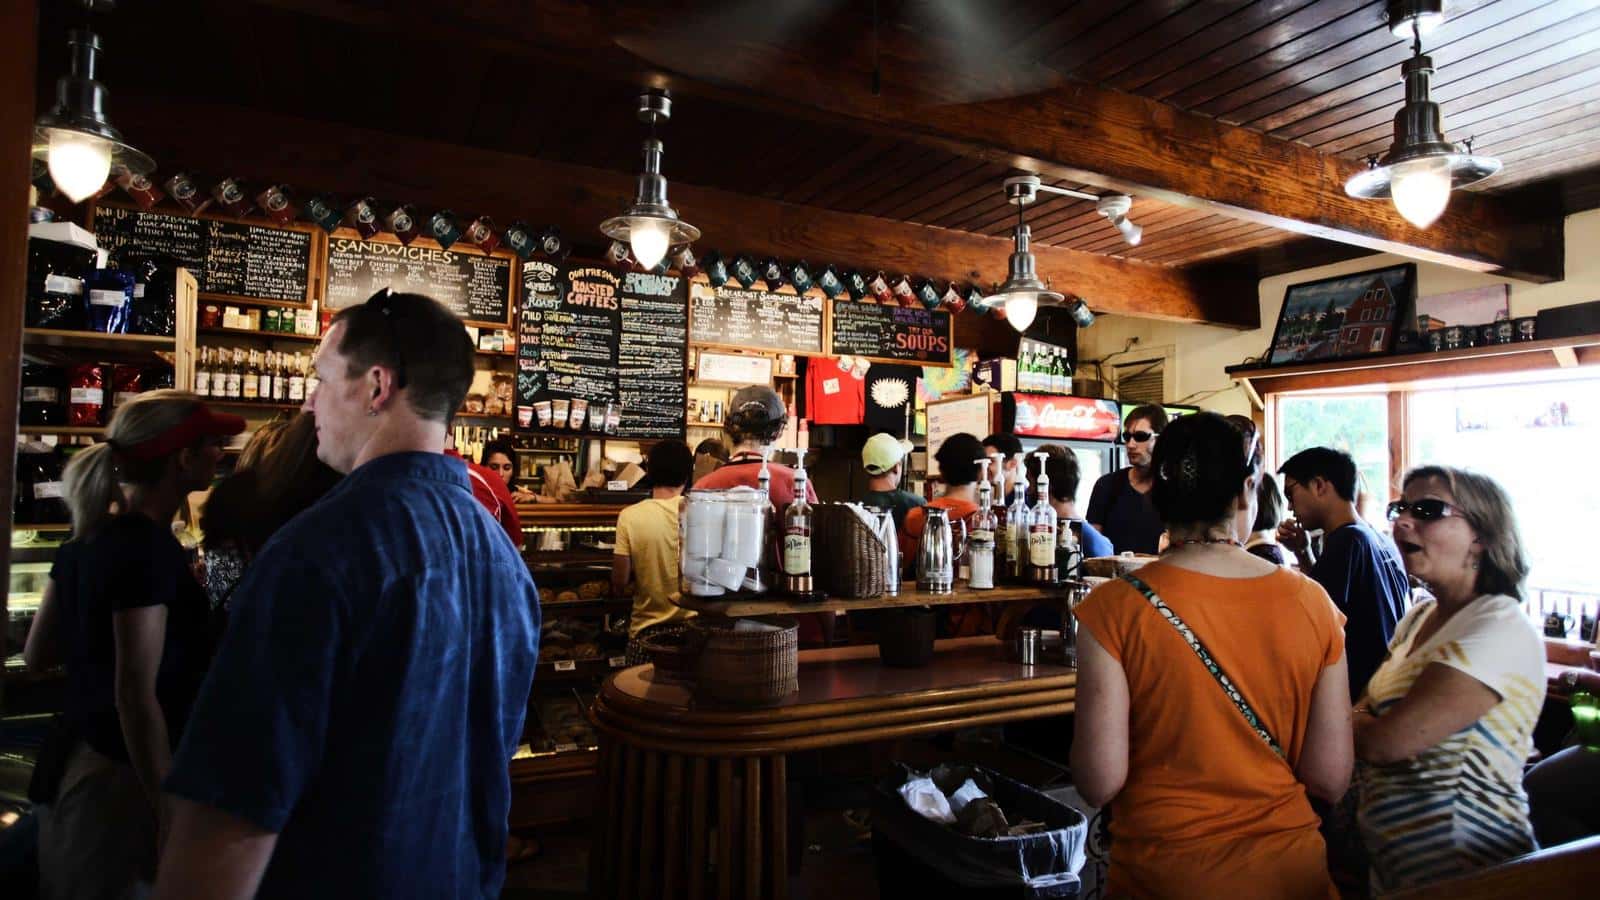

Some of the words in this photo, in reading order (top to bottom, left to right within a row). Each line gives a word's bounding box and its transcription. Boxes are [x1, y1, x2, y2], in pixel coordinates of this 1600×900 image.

[335, 239, 454, 264] SANDWICHES
[572, 280, 615, 297] ROASTED
[567, 292, 618, 310] COFFEES
[896, 331, 948, 354] SOUPS
